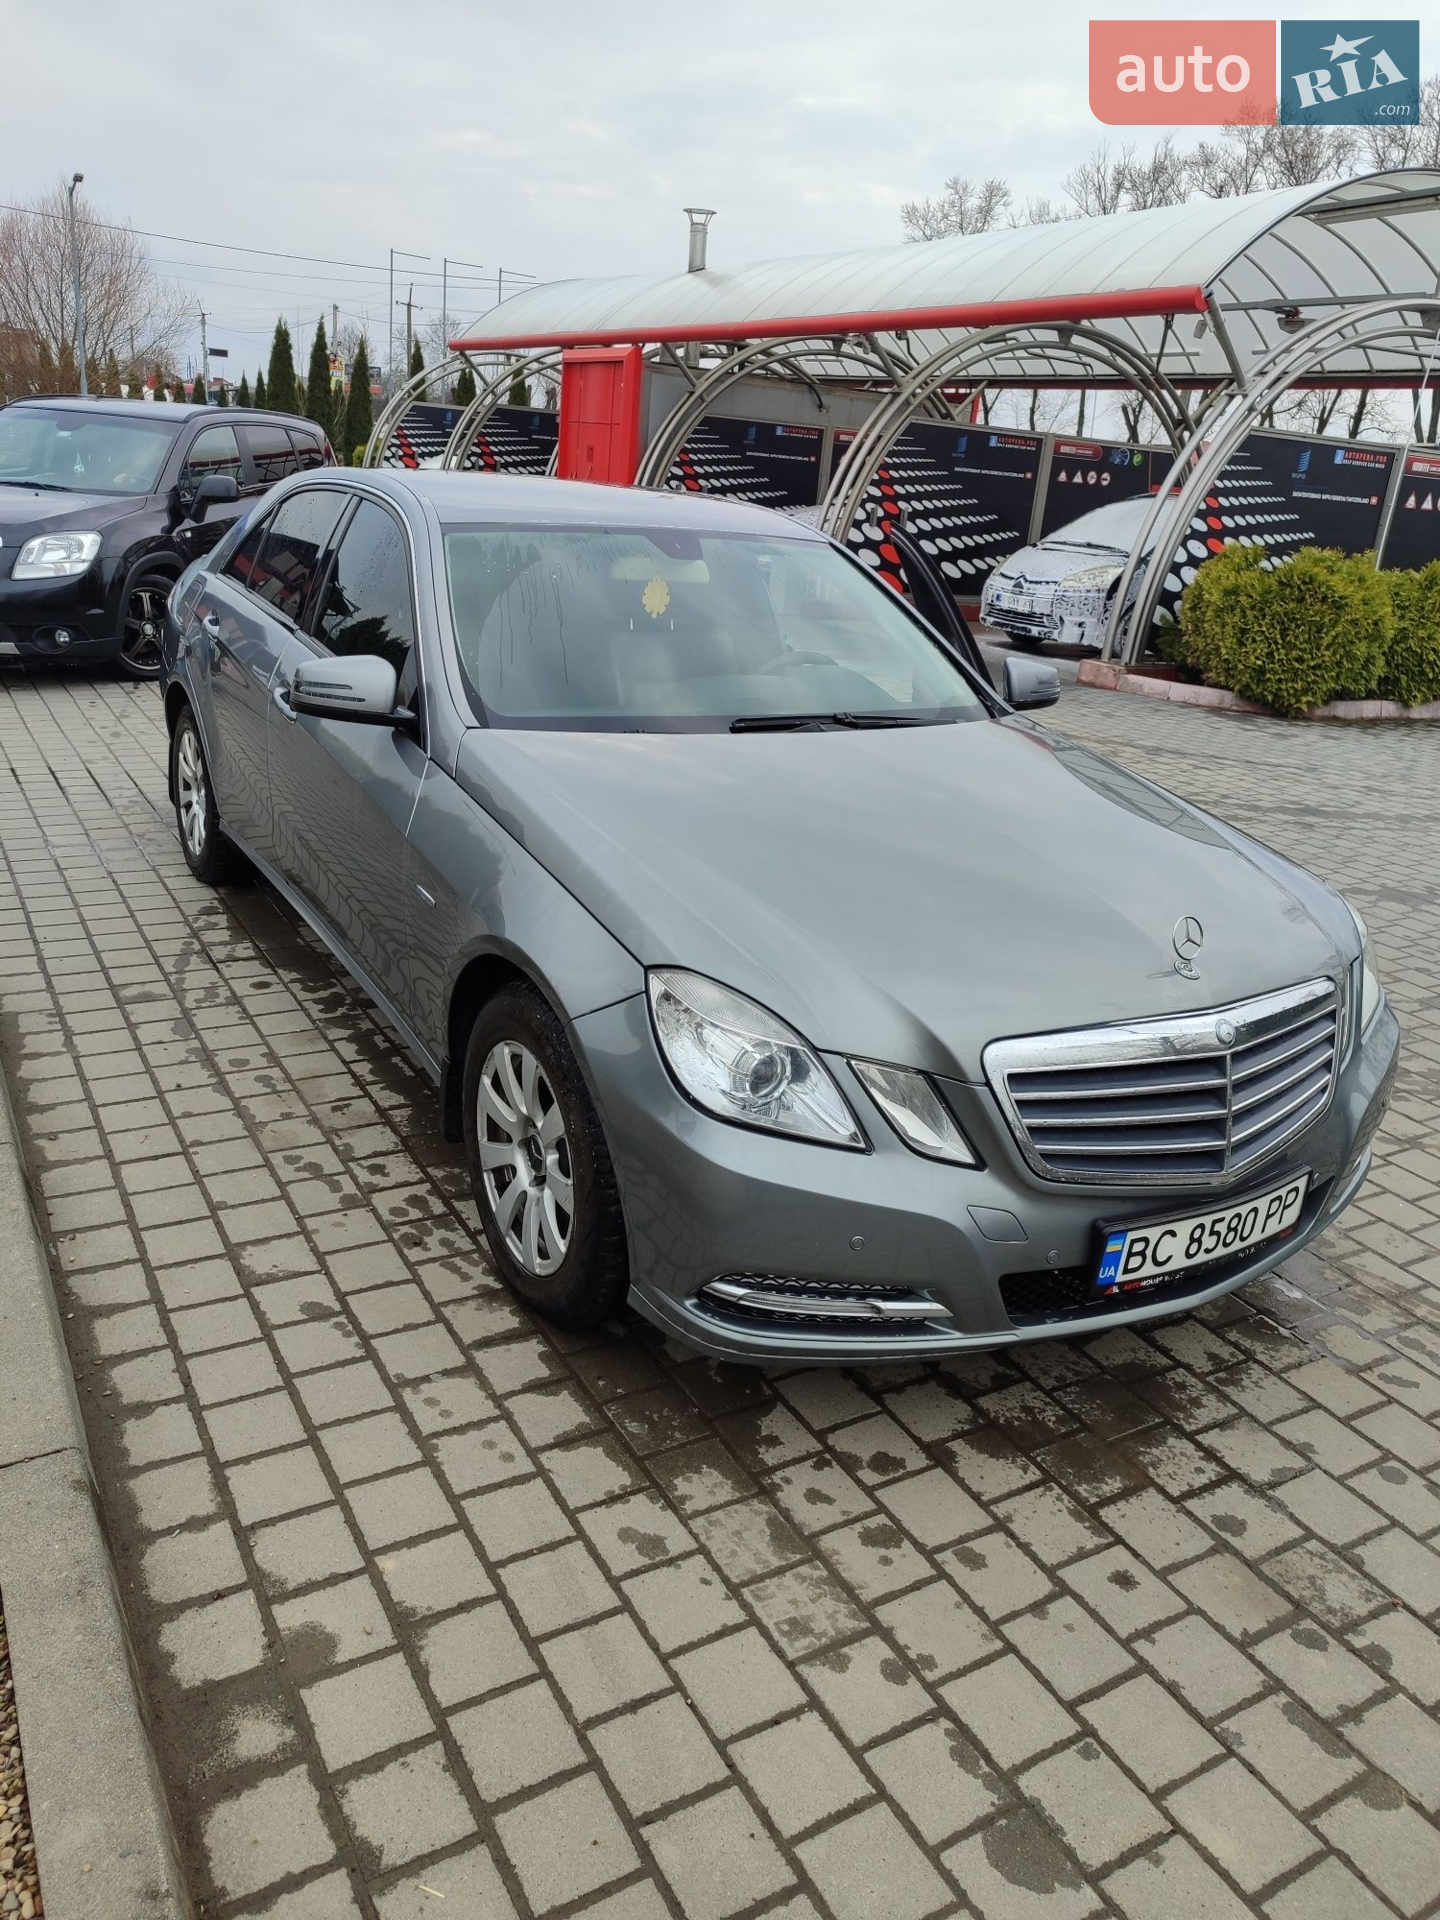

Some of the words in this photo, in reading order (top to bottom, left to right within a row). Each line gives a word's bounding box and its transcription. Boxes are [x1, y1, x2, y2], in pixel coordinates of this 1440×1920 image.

[1122, 1229, 1177, 1275] BC
[1185, 1206, 1259, 1260] 8580
[1261, 1185, 1301, 1234] PP
[1098, 1265, 1115, 1279] UA
